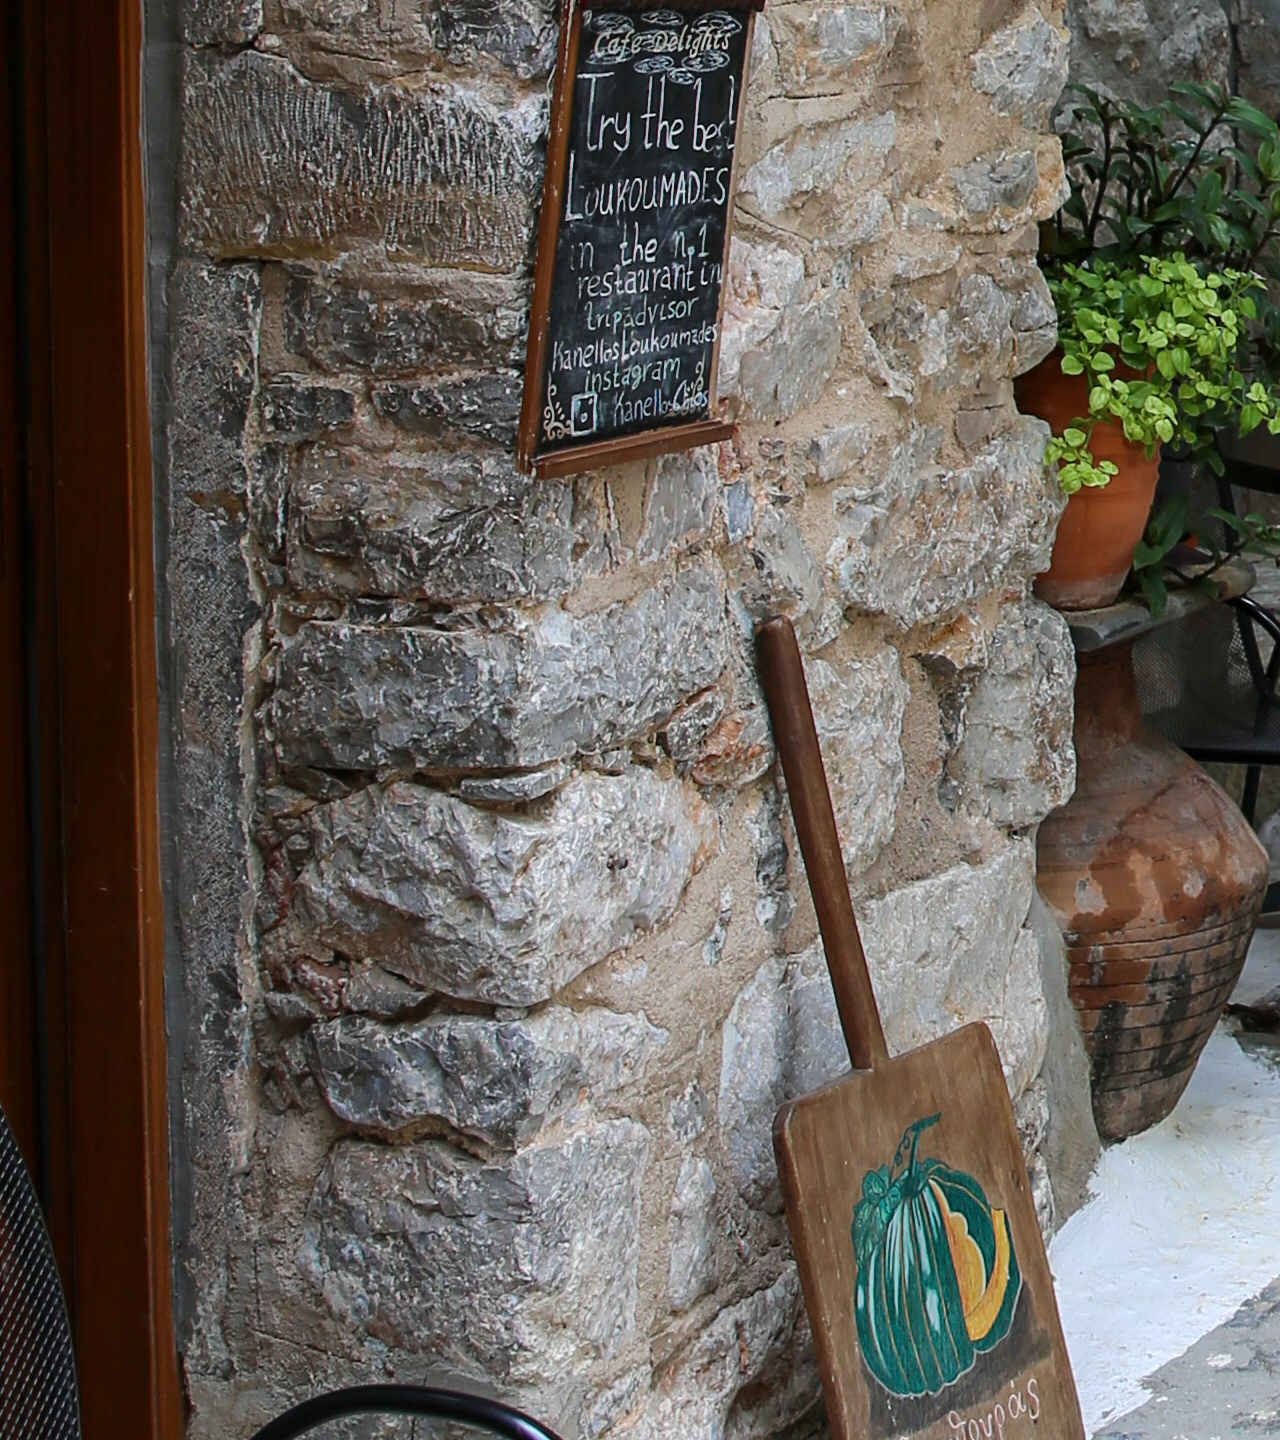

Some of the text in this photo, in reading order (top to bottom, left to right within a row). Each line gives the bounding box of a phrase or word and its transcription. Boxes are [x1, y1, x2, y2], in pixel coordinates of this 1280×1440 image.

[652, 24, 731, 57] Delights
[577, 72, 630, 151] Try
[640, 74, 685, 150] the
[619, 221, 658, 266] the
[577, 258, 722, 298] restaurant in
[585, 294, 699, 333] tripadvisor
[585, 357, 681, 392] instagram
